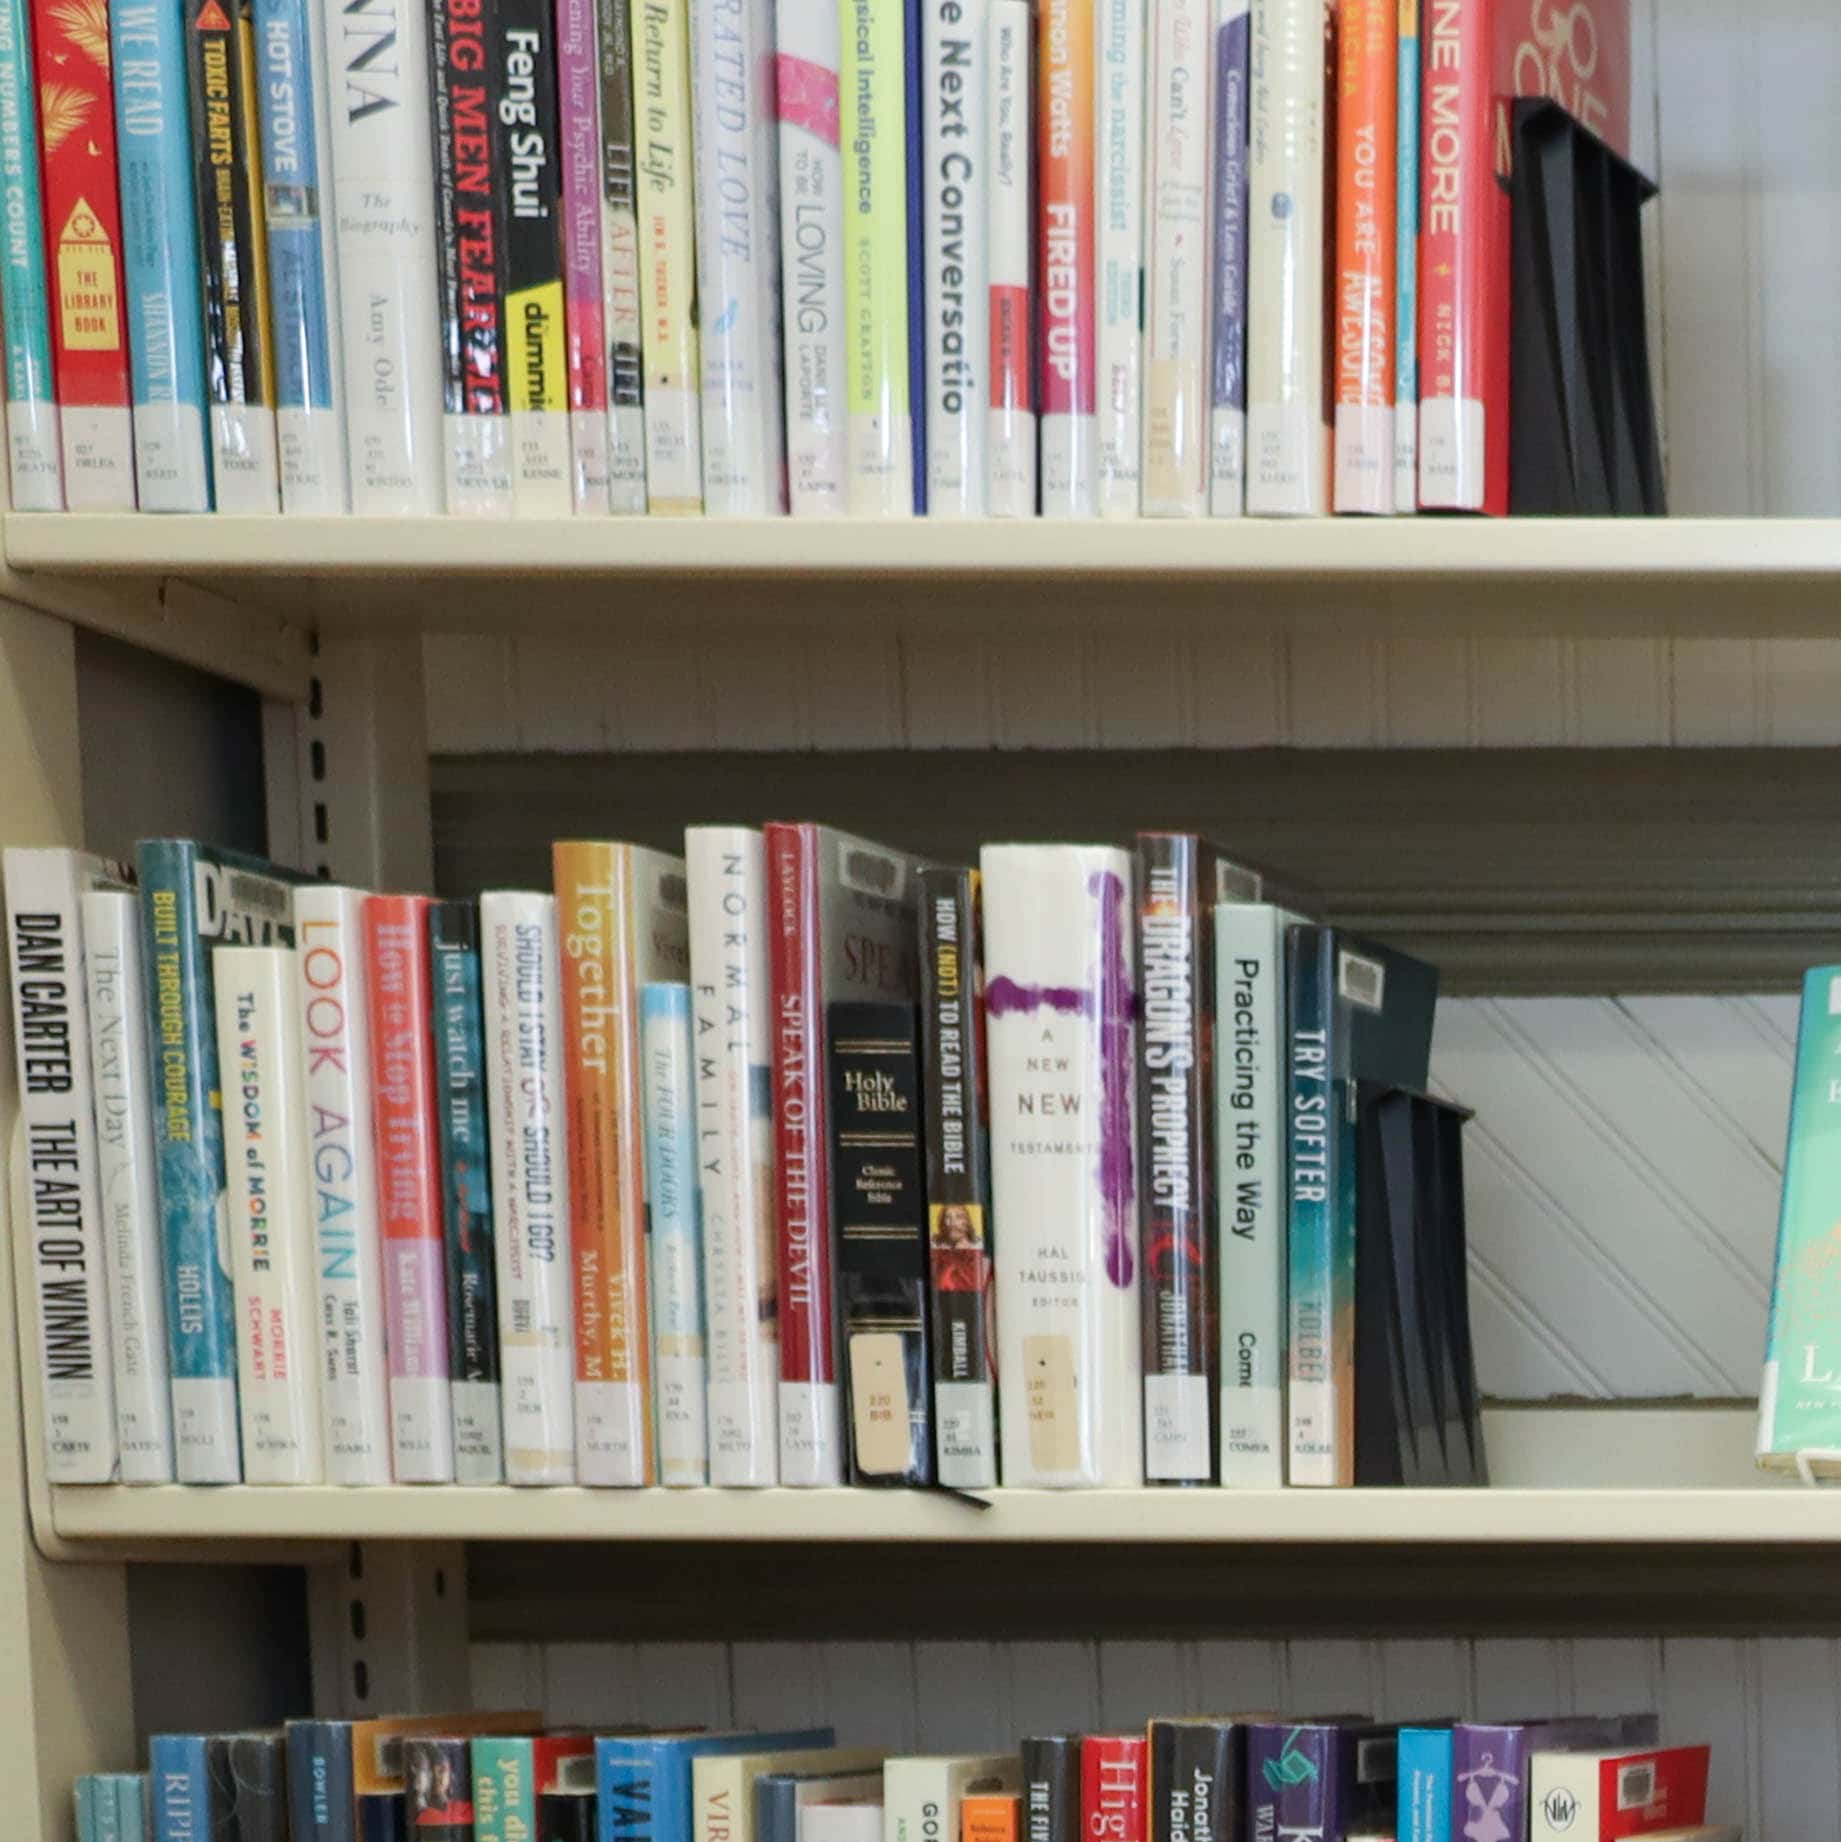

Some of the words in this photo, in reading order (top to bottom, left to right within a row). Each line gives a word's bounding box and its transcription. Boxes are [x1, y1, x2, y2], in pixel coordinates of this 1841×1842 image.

[499, 30, 541, 124] Feng
[506, 127, 545, 219] Shui
[1046, 204, 1081, 318] FIRED
[1052, 322, 1077, 380] UP
[15, 912, 62, 971] DAN
[300, 922, 348, 1075] LOOK
[569, 886, 610, 1075] Together
[24, 981, 71, 1094] CARTER
[1231, 959, 1260, 1112] Practicing
[1294, 1030, 1325, 1085] TRY
[843, 1070, 896, 1092] Holy
[856, 1091, 906, 1112] Bible
[30, 1120, 75, 1169] THE
[1235, 1125, 1255, 1170] the
[1294, 1094, 1325, 1200] SOFTER
[34, 1177, 79, 1224] ART
[312, 1106, 359, 1280] AGAIN
[1231, 1182, 1256, 1241] Way
[39, 1232, 84, 1274] OF
